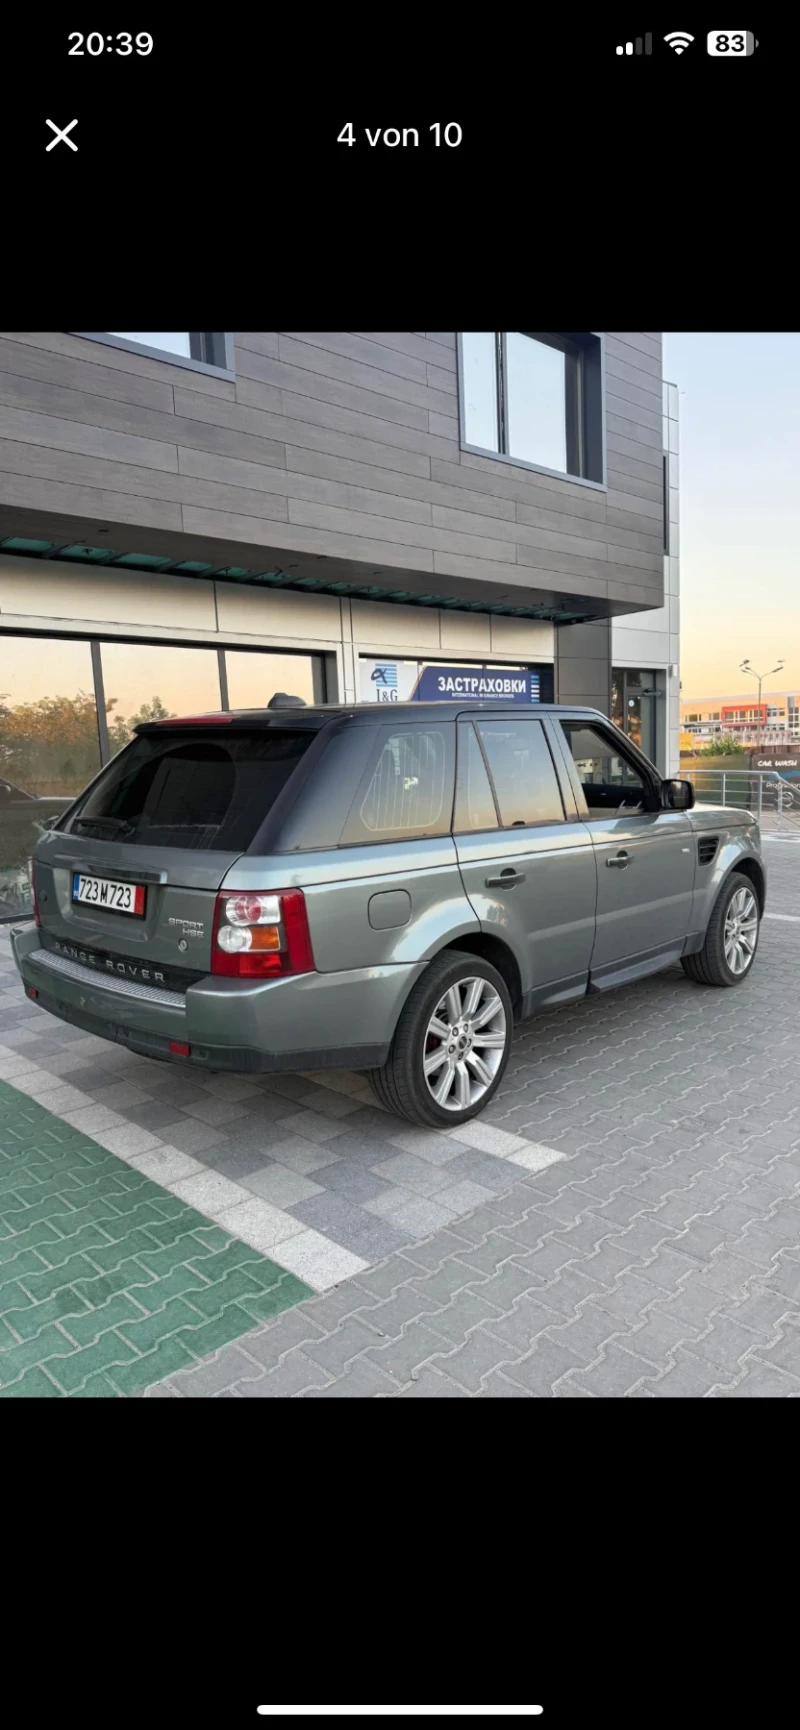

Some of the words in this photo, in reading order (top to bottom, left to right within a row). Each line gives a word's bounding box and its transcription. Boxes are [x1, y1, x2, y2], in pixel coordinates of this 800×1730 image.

[437, 676, 526, 692] ЗАСТРАХОВКИ
[168, 917, 204, 929] SPORT
[182, 927, 204, 938] HSE
[54, 941, 95, 963] RANGE
[106, 960, 165, 982] ROVER
